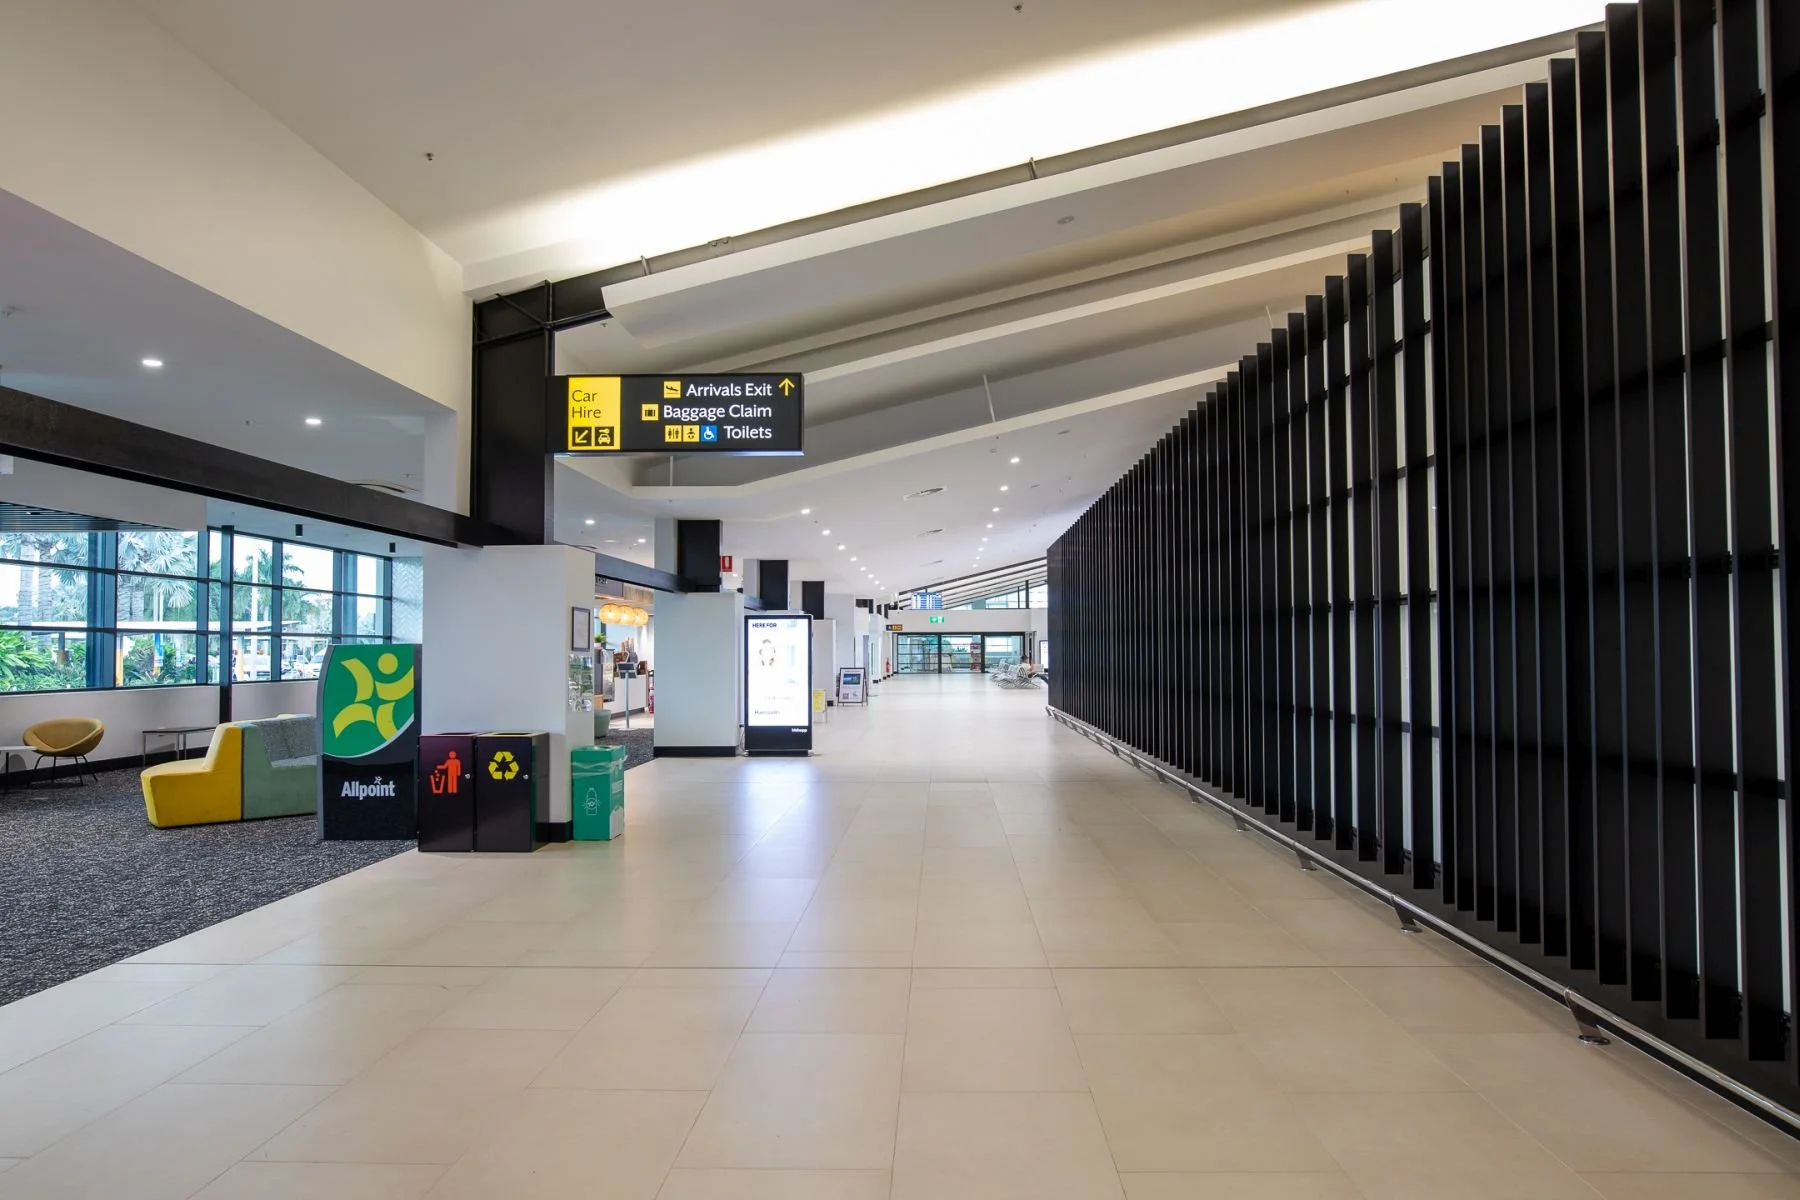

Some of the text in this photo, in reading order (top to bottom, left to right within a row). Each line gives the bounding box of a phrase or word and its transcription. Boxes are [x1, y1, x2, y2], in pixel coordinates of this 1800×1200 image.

[571, 389, 598, 403] Car
[685, 382, 773, 397] Arrivals Exit
[571, 406, 602, 419] Hire
[663, 404, 772, 422] Baggage Claim
[723, 425, 773, 439] Toilets
[341, 776, 396, 801] Allpoint
